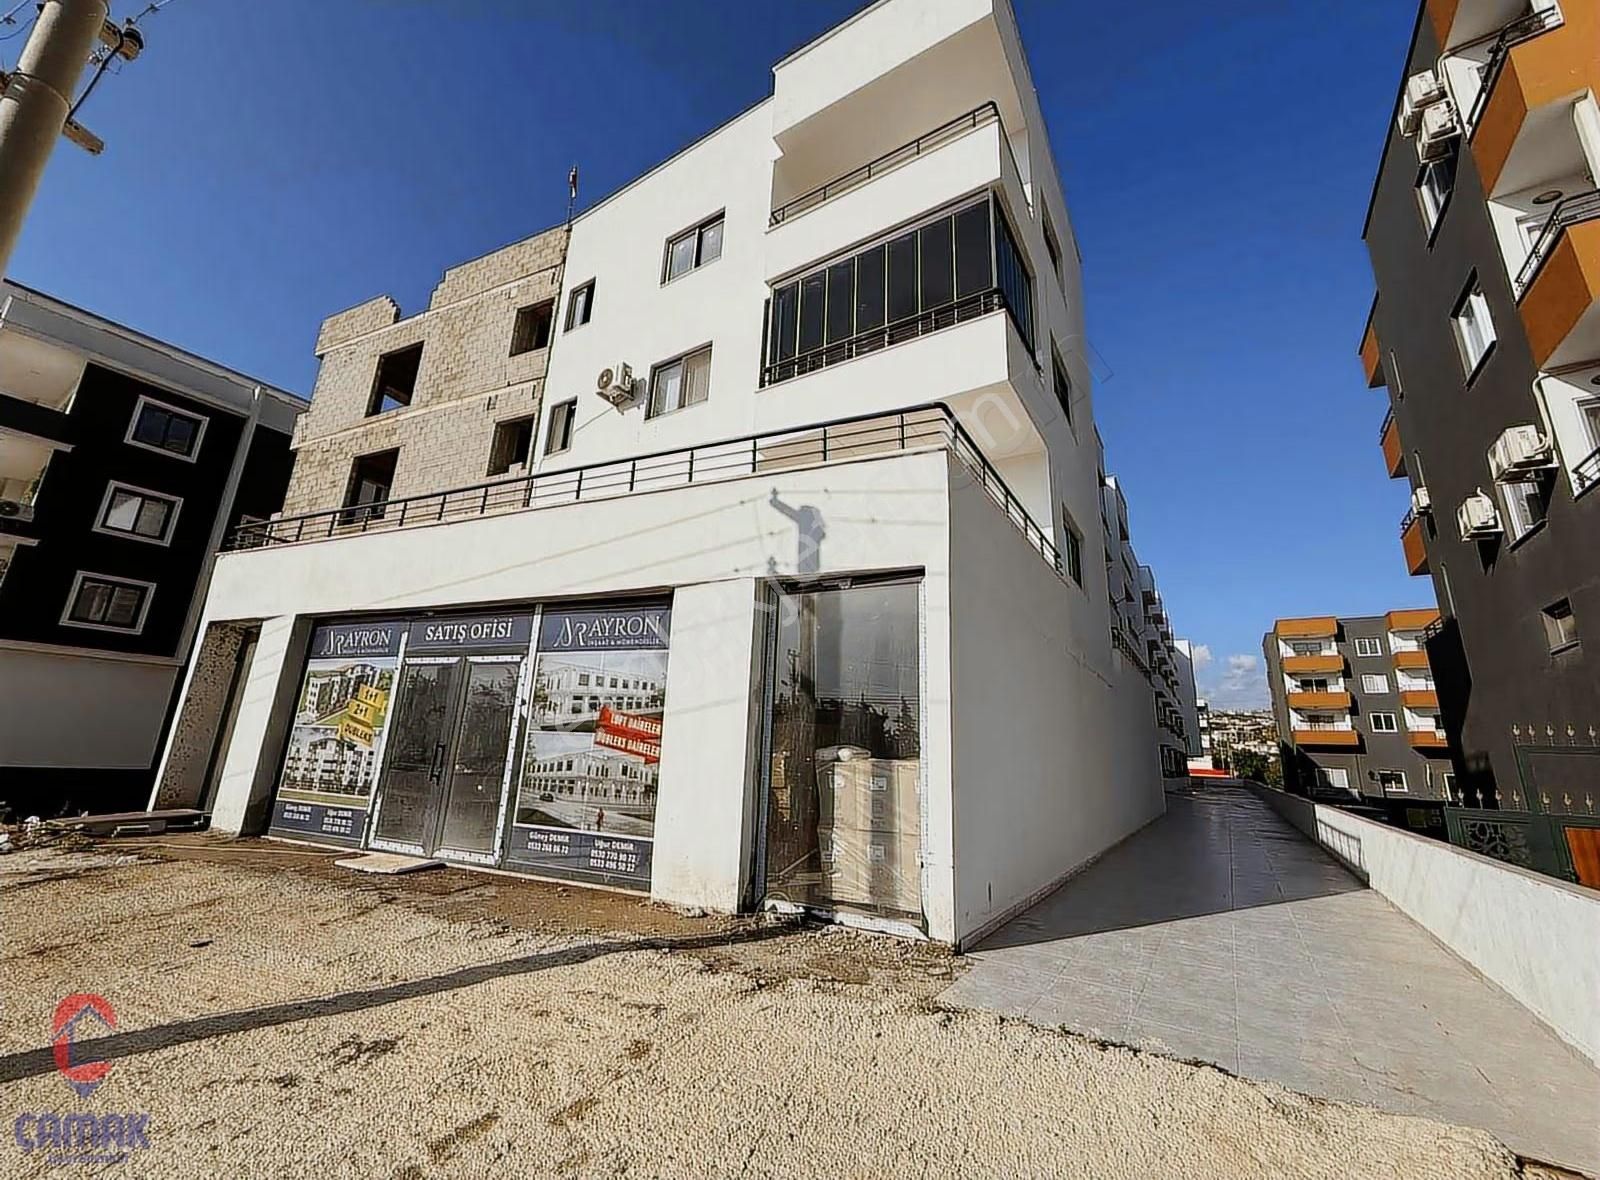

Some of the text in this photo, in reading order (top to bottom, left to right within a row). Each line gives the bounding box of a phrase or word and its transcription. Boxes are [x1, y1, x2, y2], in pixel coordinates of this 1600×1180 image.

[425, 618, 513, 643] SATIŞ OFİSİ
[364, 688, 379, 703] 1+1
[354, 703, 369, 717] 2+1
